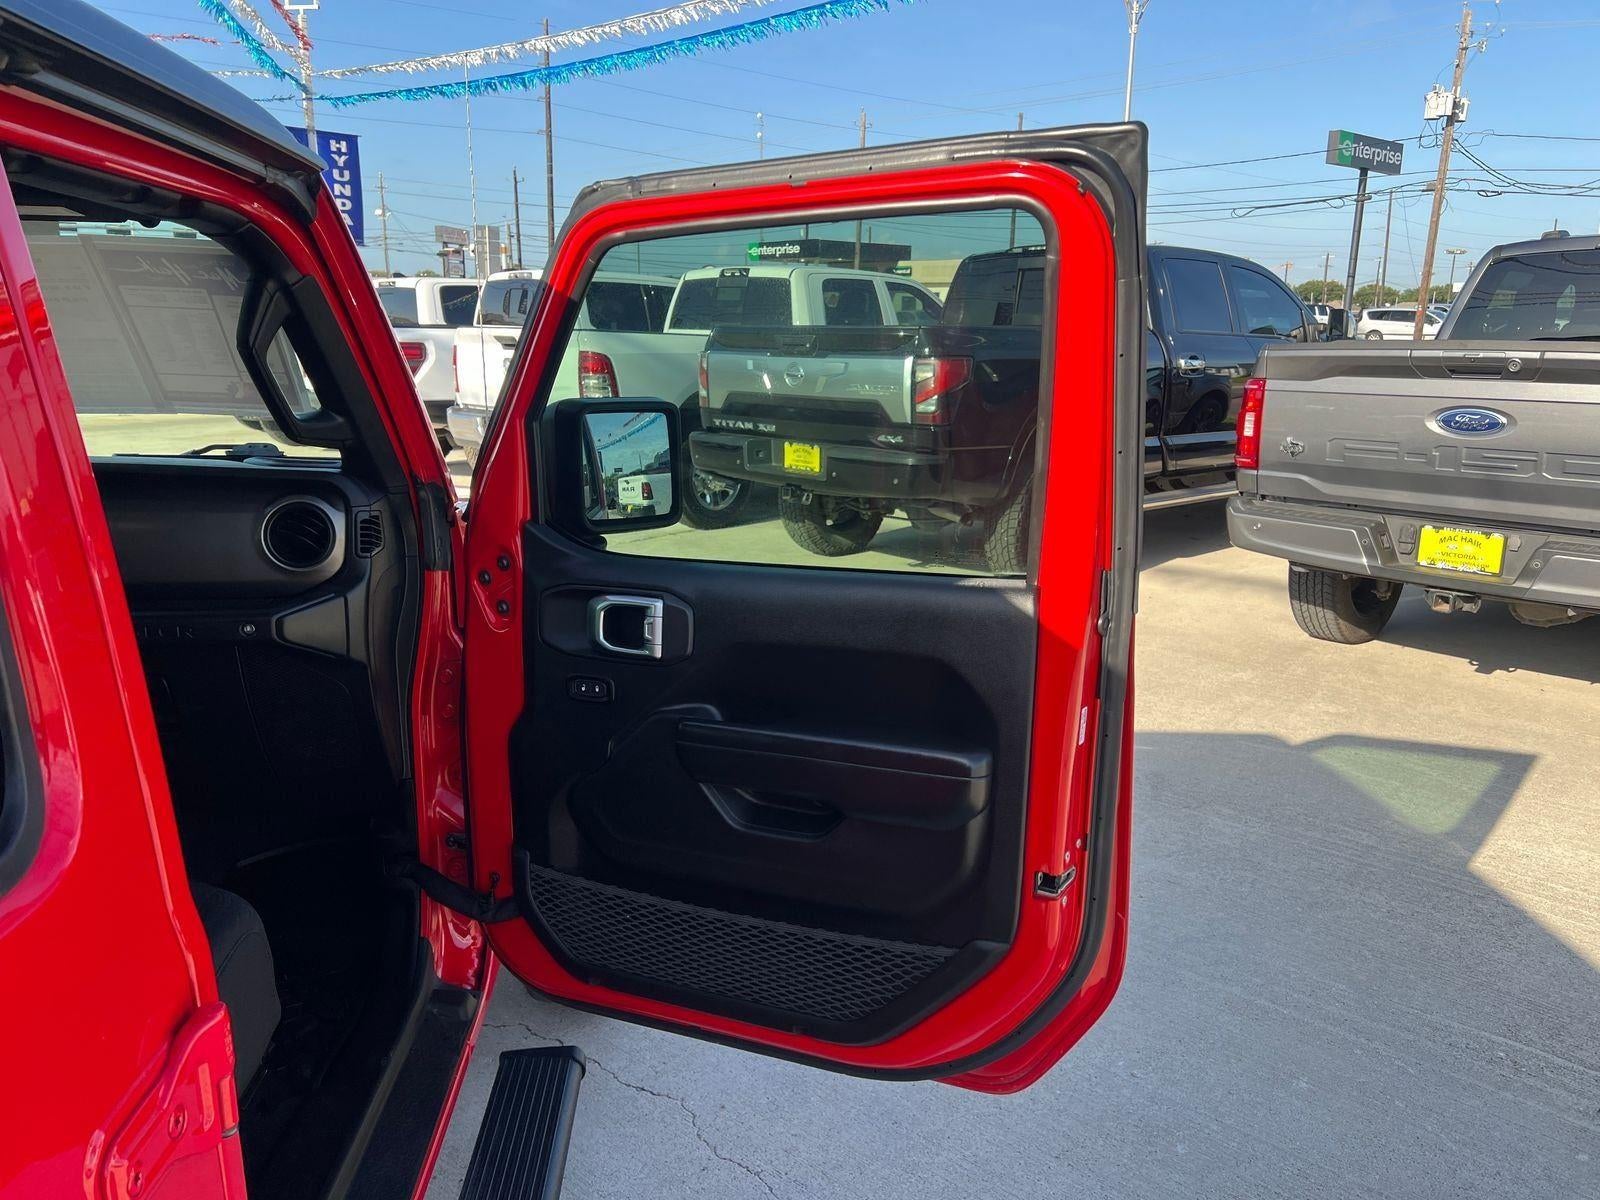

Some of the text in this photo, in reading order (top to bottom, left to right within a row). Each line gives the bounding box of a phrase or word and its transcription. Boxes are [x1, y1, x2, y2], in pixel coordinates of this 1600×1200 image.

[1339, 140, 1402, 166] enterprise
[329, 139, 354, 226] HYUNDA
[748, 243, 800, 257] enterprise
[713, 418, 753, 430] TITAN
[1439, 535, 1459, 545] MAC
[1461, 536, 1482, 549] HAIK
[1440, 551, 1477, 560] VICTORIA
